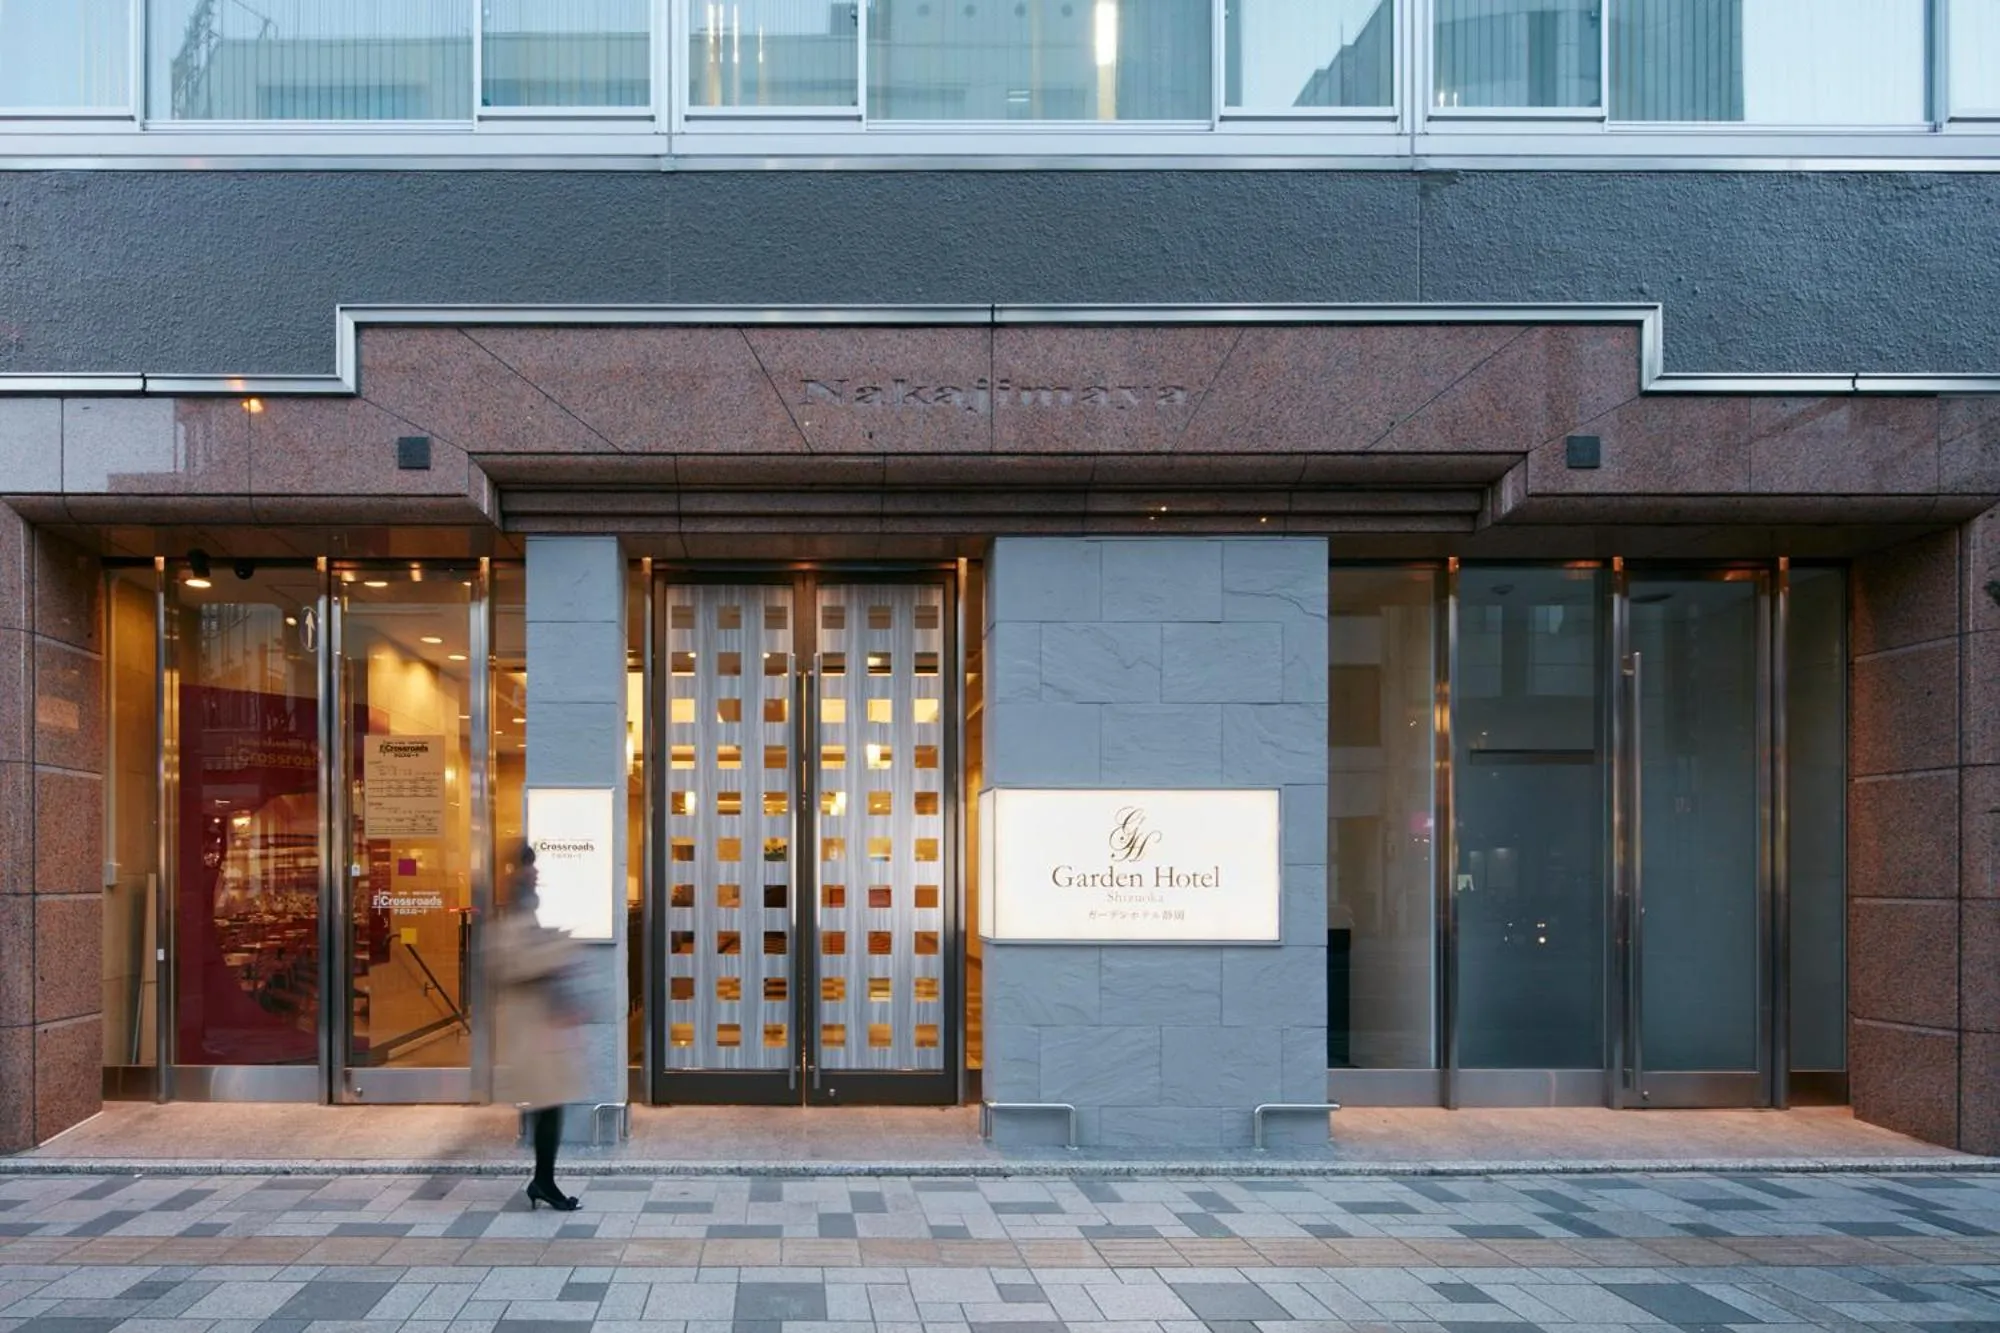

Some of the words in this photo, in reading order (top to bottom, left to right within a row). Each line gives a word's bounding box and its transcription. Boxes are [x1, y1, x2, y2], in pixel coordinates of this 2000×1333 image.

[800, 378, 1191, 413] Nakajimaya
[540, 842, 595, 851] Crossroads
[1052, 866, 1143, 887] Garden
[1154, 866, 1220, 887] Hotel
[380, 895, 442, 905] Crossroads
[1106, 891, 1164, 903] Shizuoka
